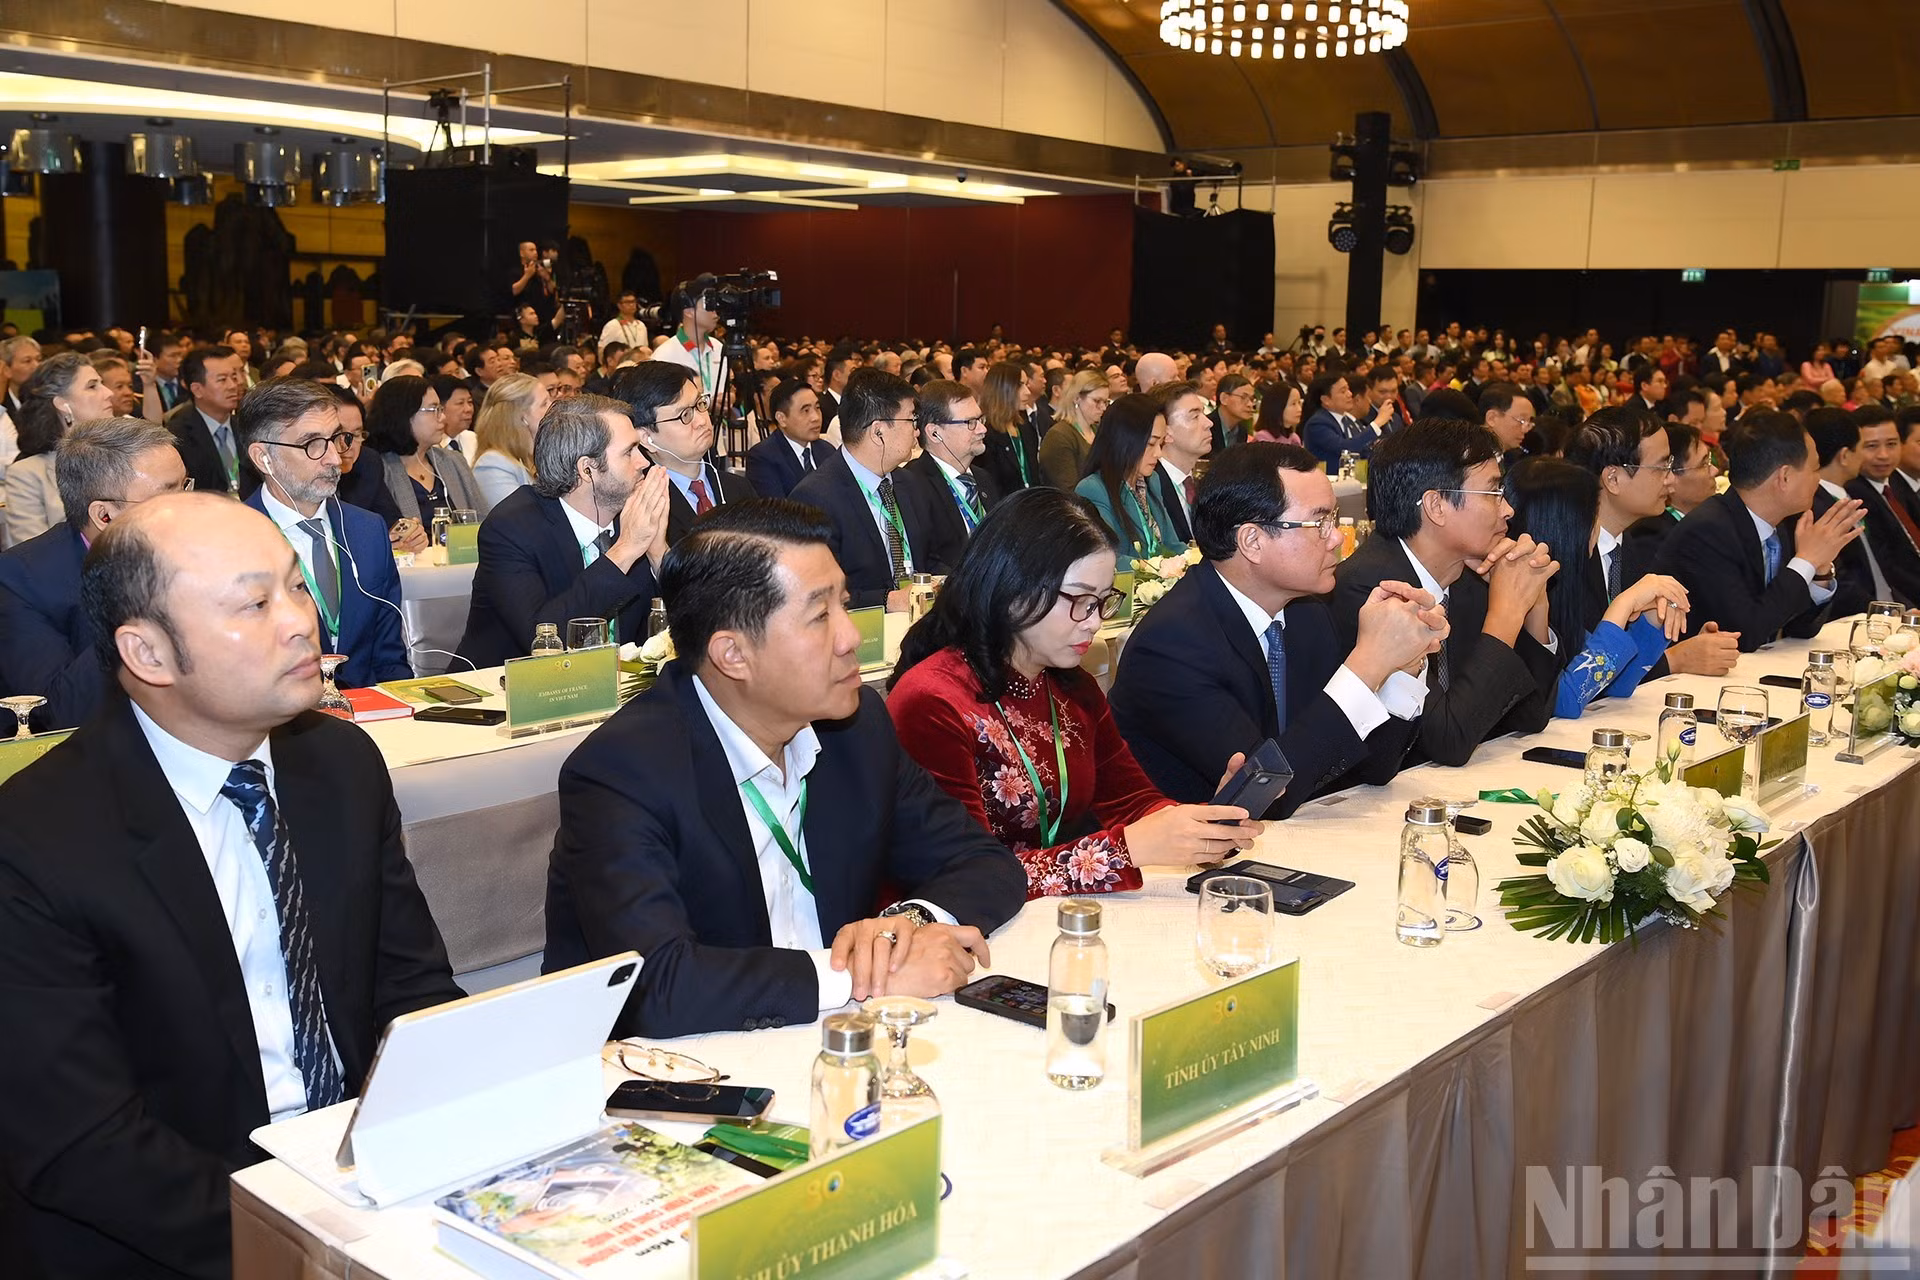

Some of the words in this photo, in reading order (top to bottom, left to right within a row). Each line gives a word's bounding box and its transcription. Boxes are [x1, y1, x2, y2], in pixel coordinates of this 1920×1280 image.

[568, 684, 588, 693] FRANCE
[1164, 1063, 1199, 1089] TỈNH
[1201, 1053, 1220, 1075] ỦY
[1221, 1041, 1248, 1066] TÂY
[1249, 1028, 1280, 1054] NINH
[809, 1221, 875, 1265] THANH
[878, 1200, 918, 1233] HÓA
